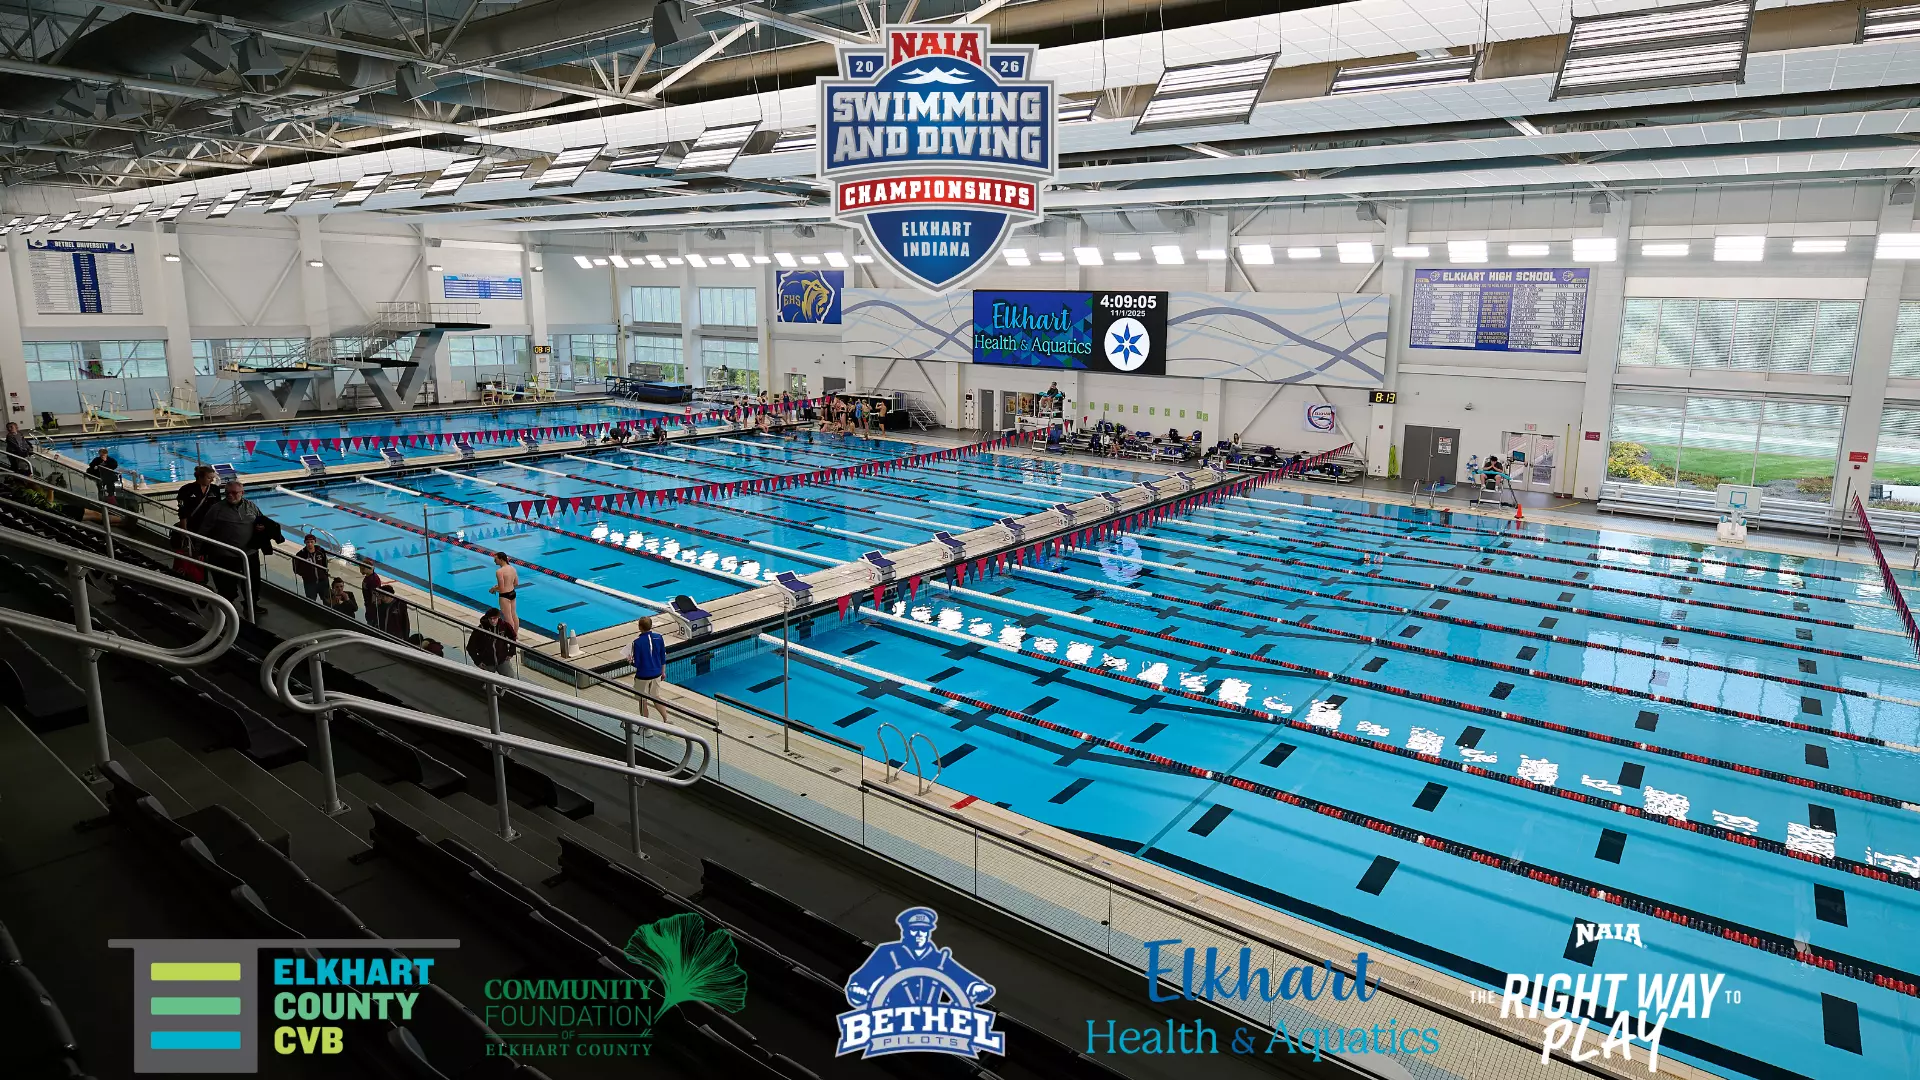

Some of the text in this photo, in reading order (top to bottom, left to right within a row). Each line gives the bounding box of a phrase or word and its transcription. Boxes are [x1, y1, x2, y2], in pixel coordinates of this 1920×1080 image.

[1443, 271, 1556, 282] ELKHART HIGH SCHOOL
[783, 294, 801, 307] EHS
[1100, 294, 1157, 309] 4:09:05
[992, 302, 1073, 333] Elkhart
[1110, 309, 1146, 317] 11/1/2025
[975, 334, 1092, 356] Health & Aquatics
[1376, 392, 1395, 403] 8:13
